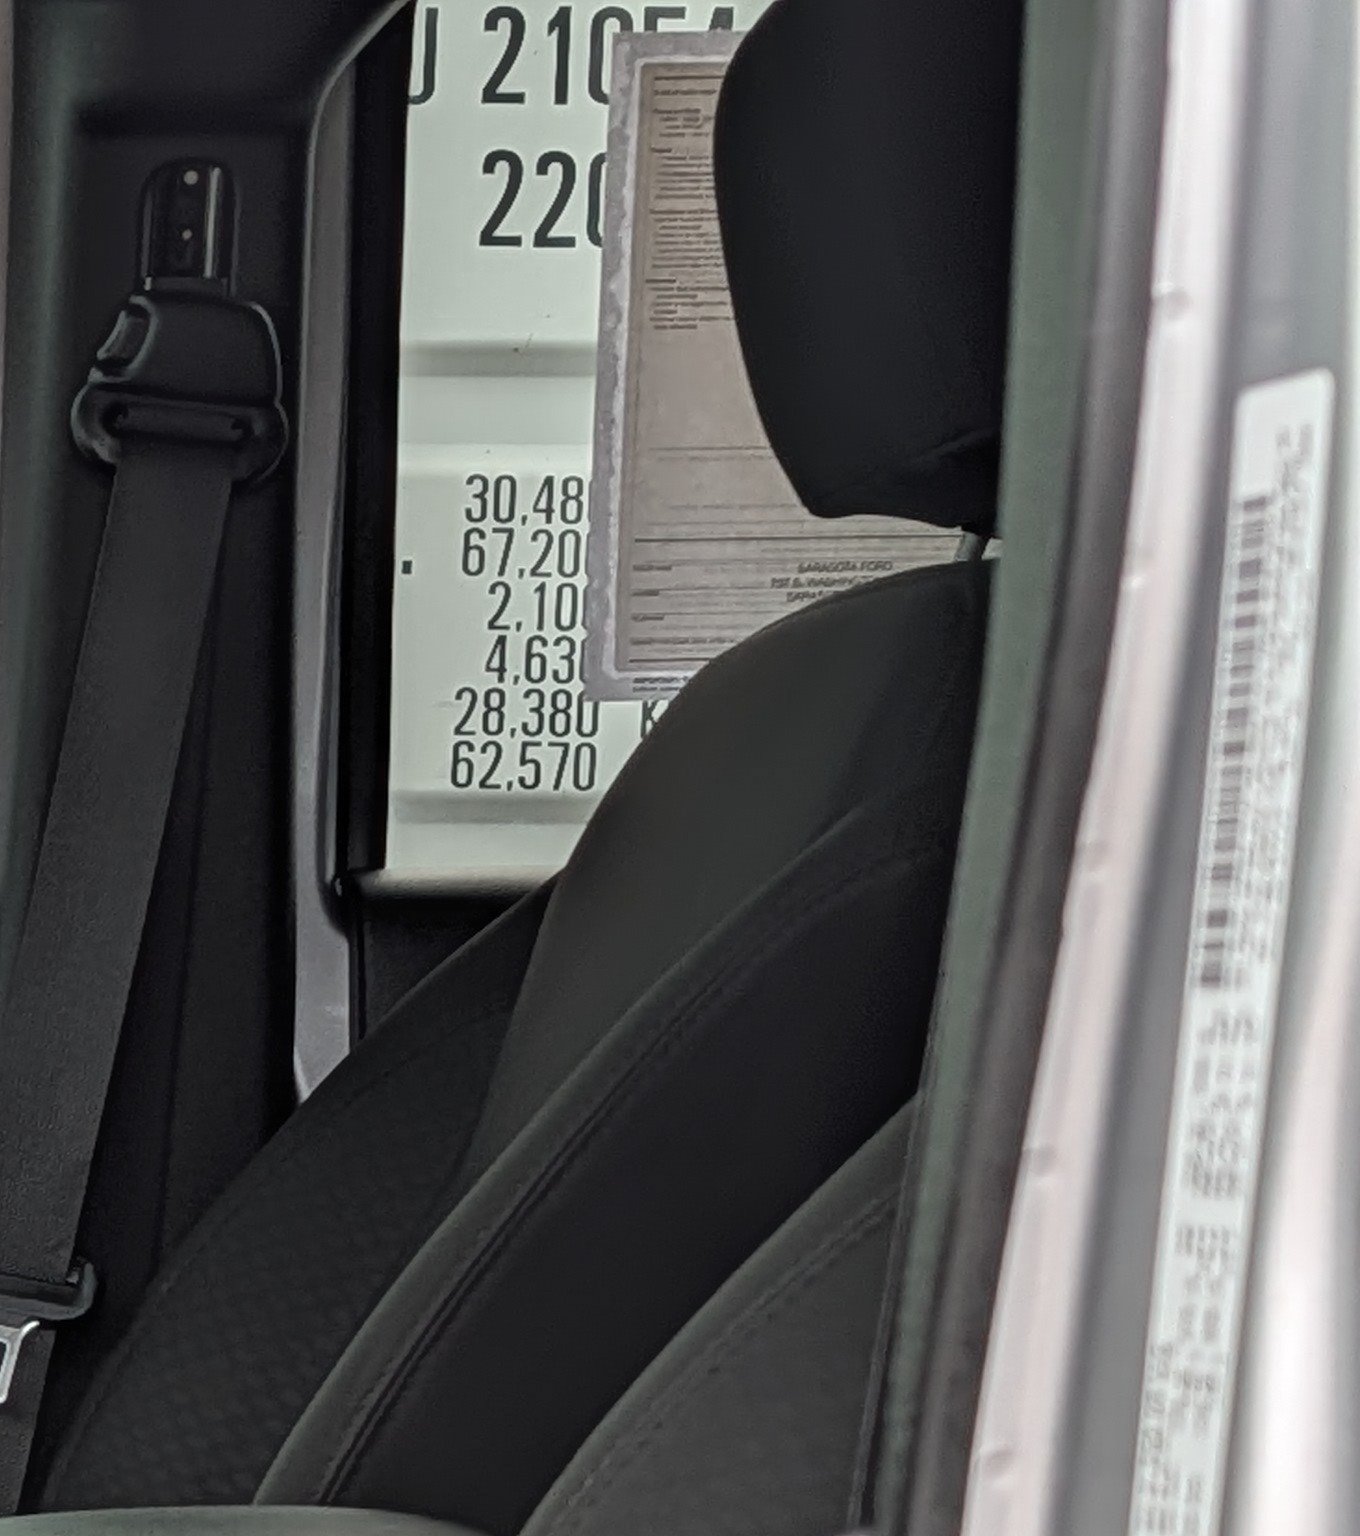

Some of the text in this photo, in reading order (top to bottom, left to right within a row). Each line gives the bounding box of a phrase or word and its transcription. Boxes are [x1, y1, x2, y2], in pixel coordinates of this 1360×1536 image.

[465, 474, 586, 525] 30,48
[462, 527, 586, 578] 67,20
[487, 581, 584, 632] 2,10
[485, 634, 581, 685] 4,63
[453, 687, 600, 738] 28,380
[450, 740, 597, 792] 62,570
